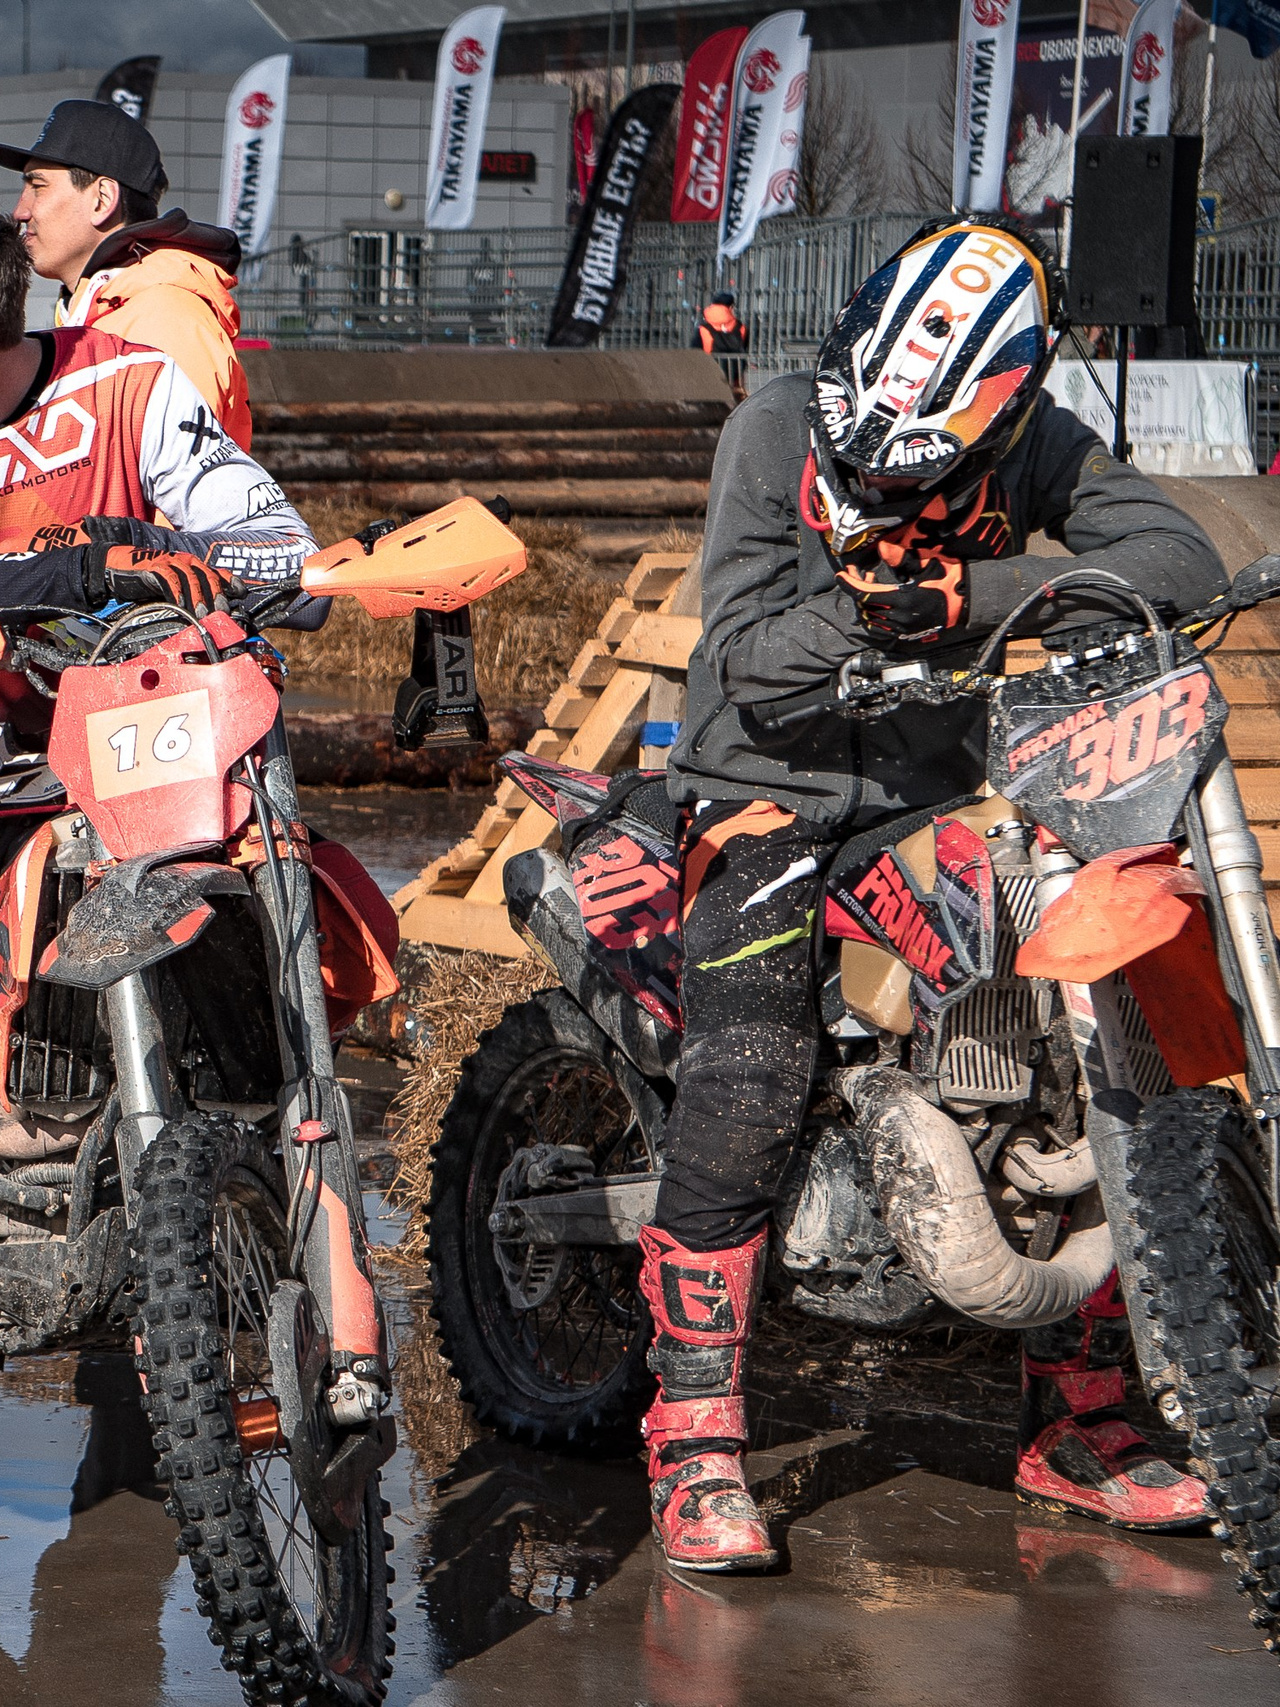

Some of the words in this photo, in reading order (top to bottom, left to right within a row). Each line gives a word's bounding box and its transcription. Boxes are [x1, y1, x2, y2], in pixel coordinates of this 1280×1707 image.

[970, 37, 996, 176] TAKAYAMA
[439, 83, 473, 203] TAKAYAMA
[572, 207, 623, 325] БУЙНЫЕ
[602, 117, 652, 207] ЕСТЬ?
[816, 381, 854, 441] Airoh
[21, 457, 93, 490] MOTORS
[886, 433, 956, 468] Airoh
[107, 713, 192, 772] 16
[1007, 701, 1108, 773] PROMAX
[1064, 672, 1211, 801] 303
[837, 888, 865, 917] FACTORY
[853, 853, 954, 986] PROMAX
